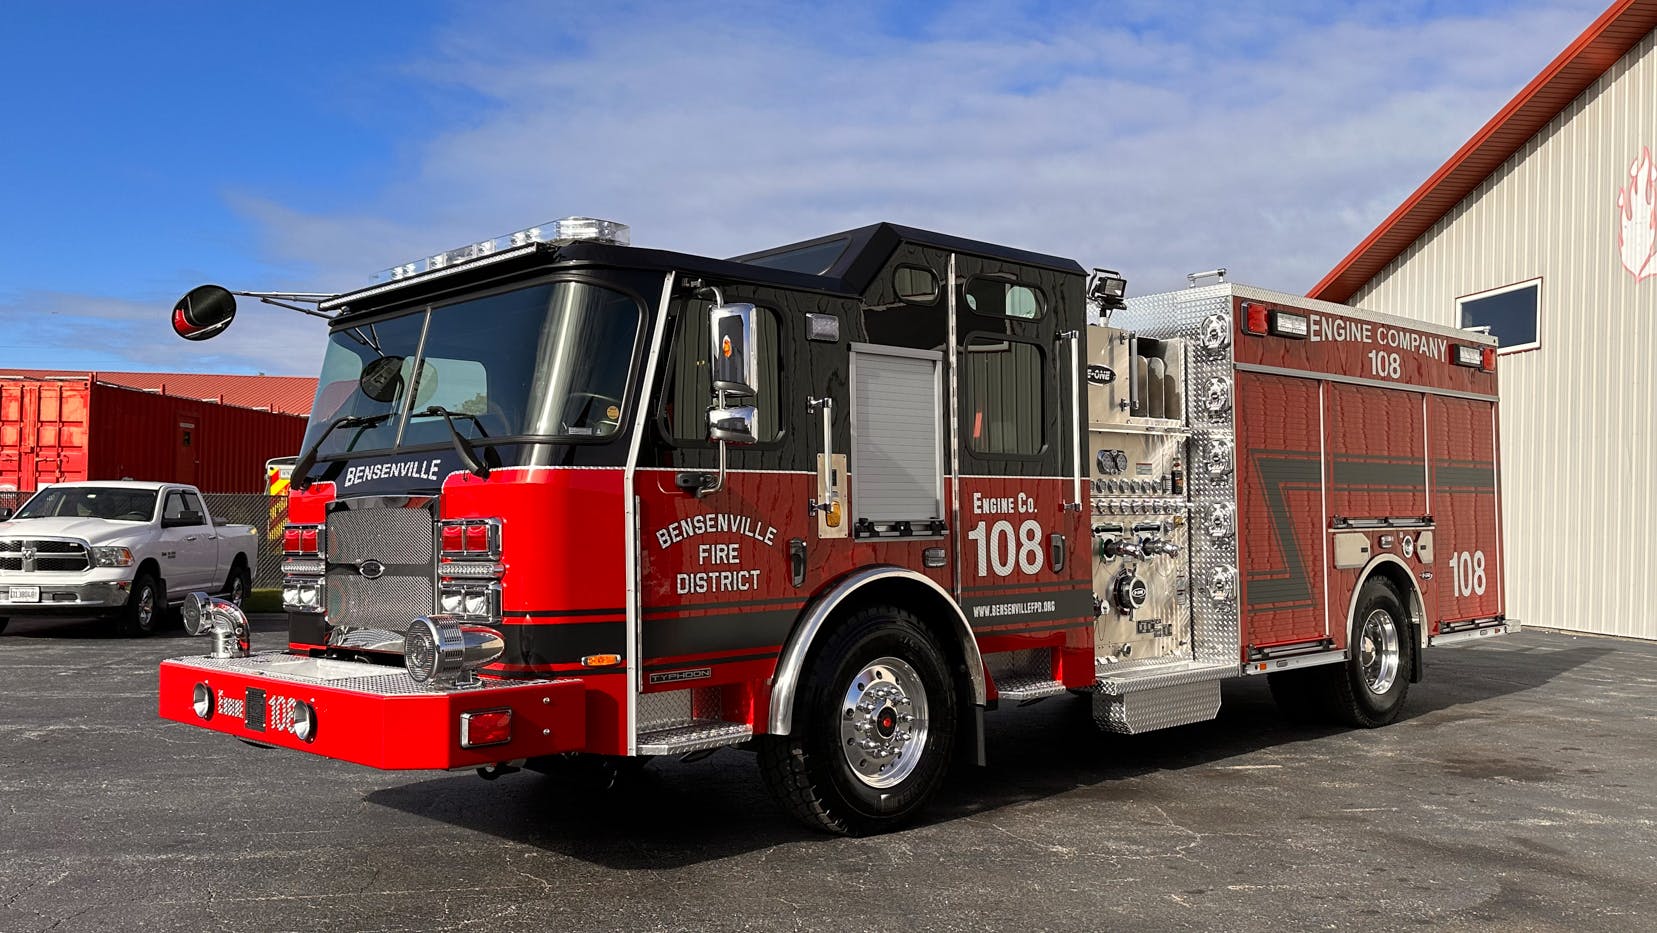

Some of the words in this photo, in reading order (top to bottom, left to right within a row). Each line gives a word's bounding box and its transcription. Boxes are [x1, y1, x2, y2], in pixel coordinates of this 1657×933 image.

[1310, 314, 1372, 343] ENGINE
[1377, 327, 1447, 363] COMPANY
[1368, 349, 1401, 379] 108
[344, 459, 441, 487] BENSENVILLE
[656, 513, 778, 549] BENSENVILLE
[699, 543, 740, 565] FIRE
[968, 520, 1044, 577] 108
[677, 569, 761, 594] DISTRICT
[1449, 550, 1487, 597] 108
[652, 670, 710, 681] TYPHOON
